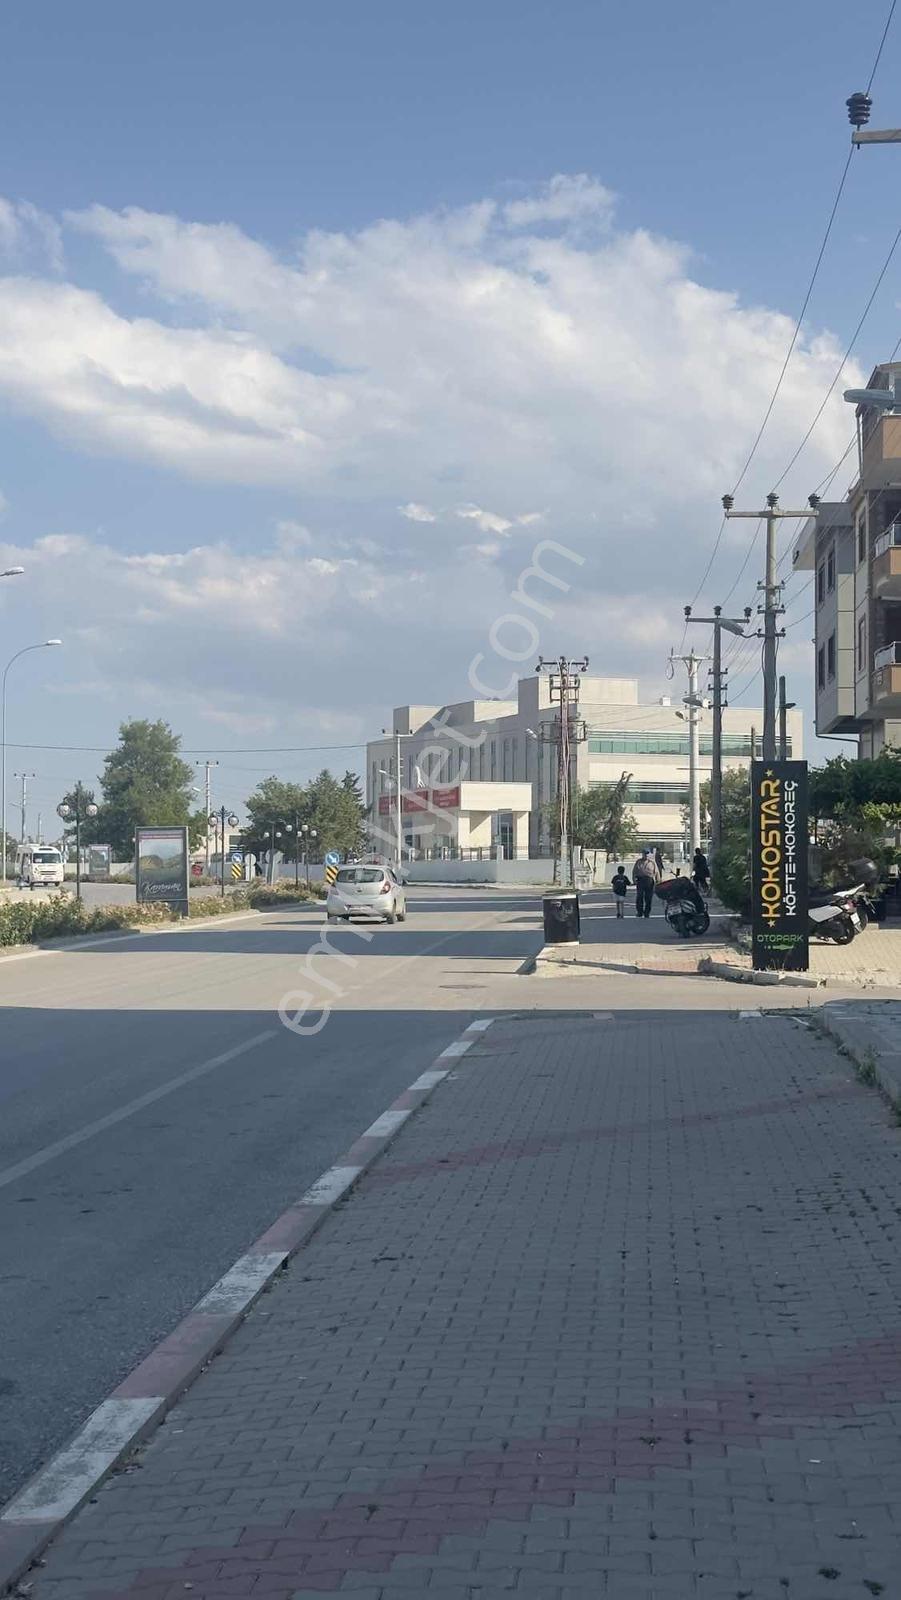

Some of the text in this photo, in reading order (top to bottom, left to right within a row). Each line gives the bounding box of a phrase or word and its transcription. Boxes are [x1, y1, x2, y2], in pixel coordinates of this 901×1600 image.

[761, 779, 781, 918] KOKOSTAR
[784, 780, 798, 916] KÖFTE-KOKOREÇ
[757, 934, 804, 943] OTOPARK
